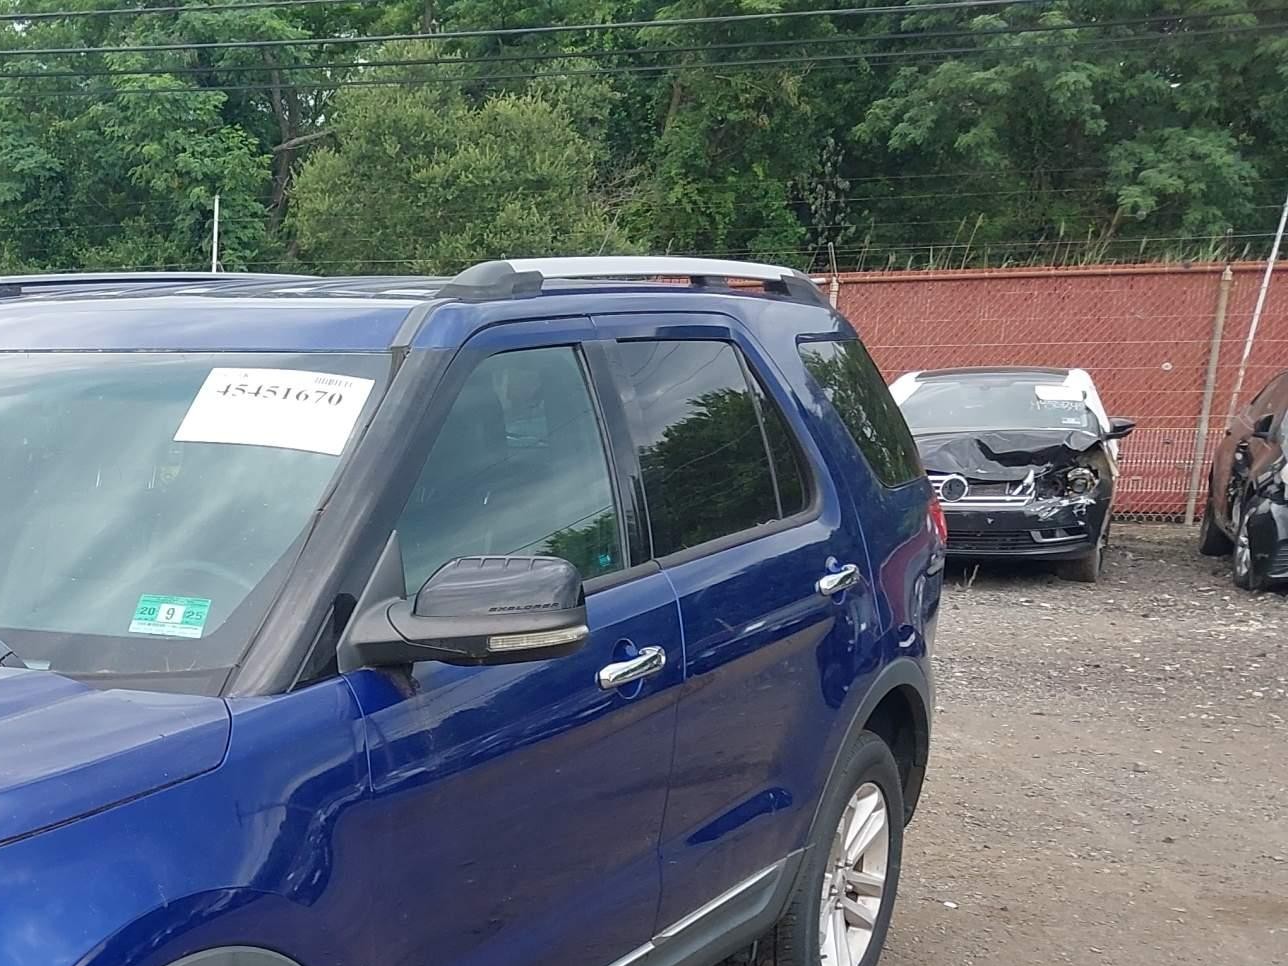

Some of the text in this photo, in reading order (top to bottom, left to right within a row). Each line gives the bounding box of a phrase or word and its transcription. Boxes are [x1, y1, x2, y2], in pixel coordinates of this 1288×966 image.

[216, 383, 343, 407] 45451670
[139, 606, 156, 616] 20
[165, 607, 175, 621] 9
[488, 602, 560, 612] EXPLORER
